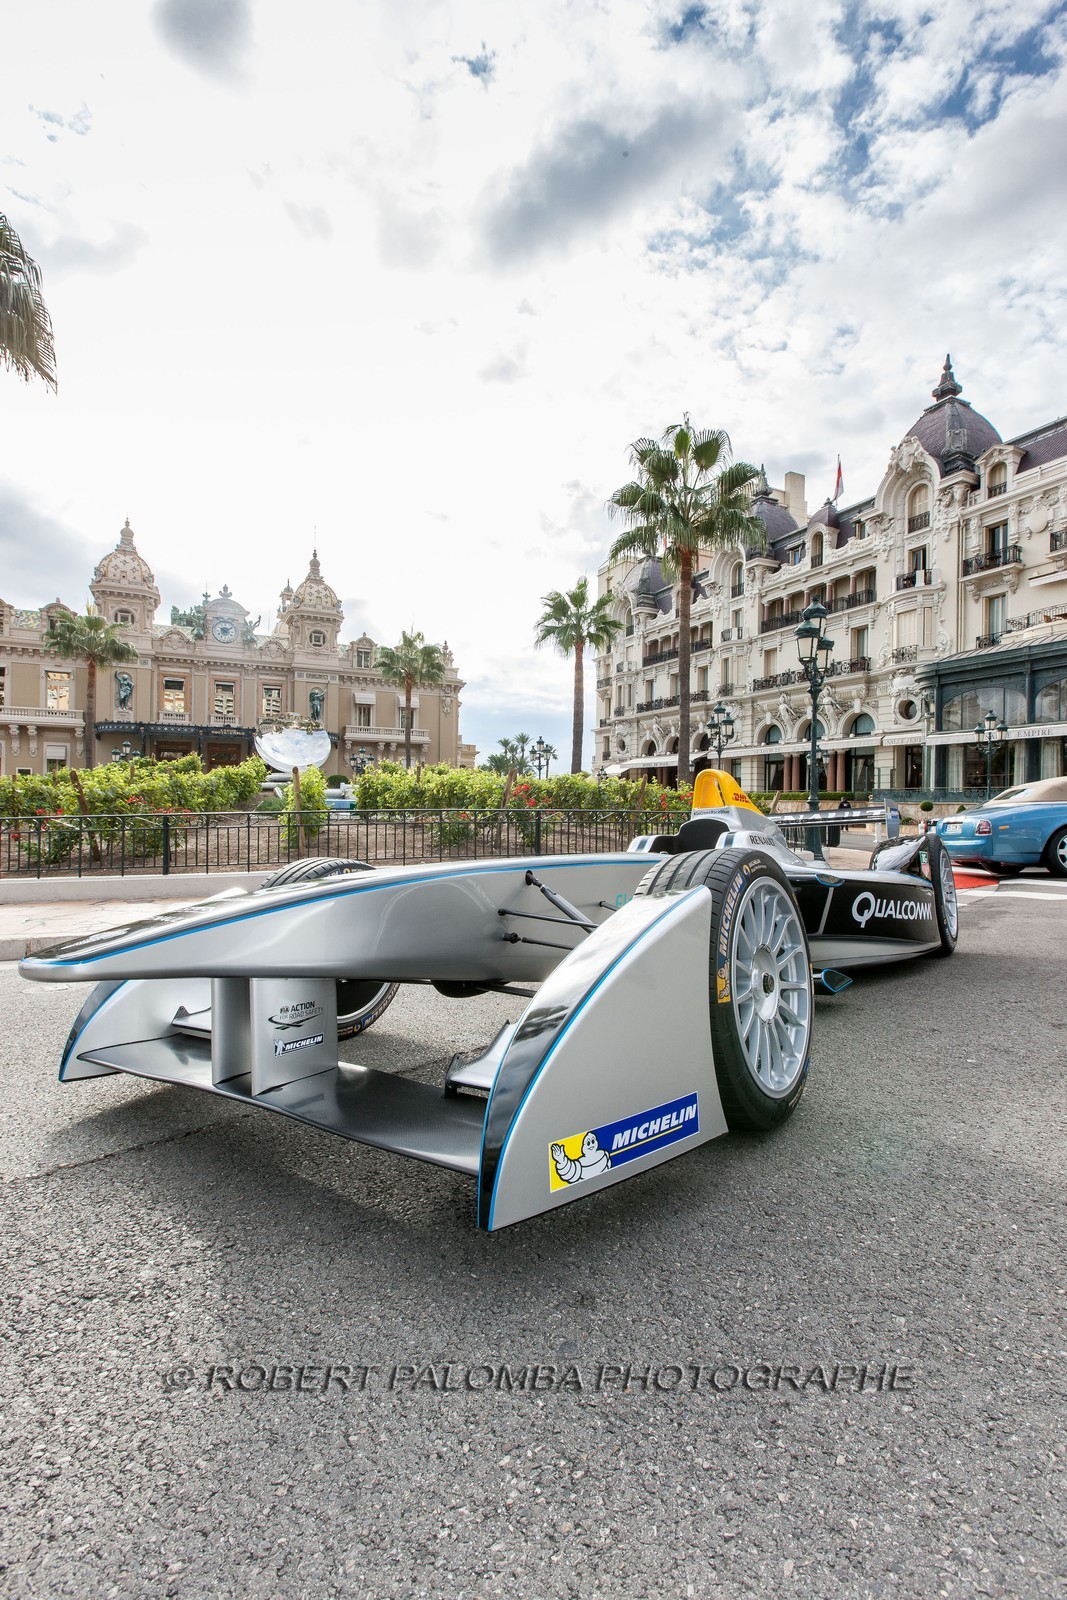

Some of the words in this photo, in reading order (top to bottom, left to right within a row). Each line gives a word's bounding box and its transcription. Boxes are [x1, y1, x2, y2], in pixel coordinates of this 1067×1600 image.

[1017, 728, 1054, 738] EMPIRE
[732, 792, 750, 804] DHL
[749, 835, 776, 846] RENAULT
[719, 872, 744, 957] MICHELIN
[851, 891, 933, 928] QUALCOMM
[291, 1001, 316, 1012] ACTION
[289, 1010, 305, 1019] ROAD
[305, 1007, 324, 1016] SAFETY
[285, 1035, 323, 1050] MICHELIN
[612, 1103, 697, 1150] MICHELIN
